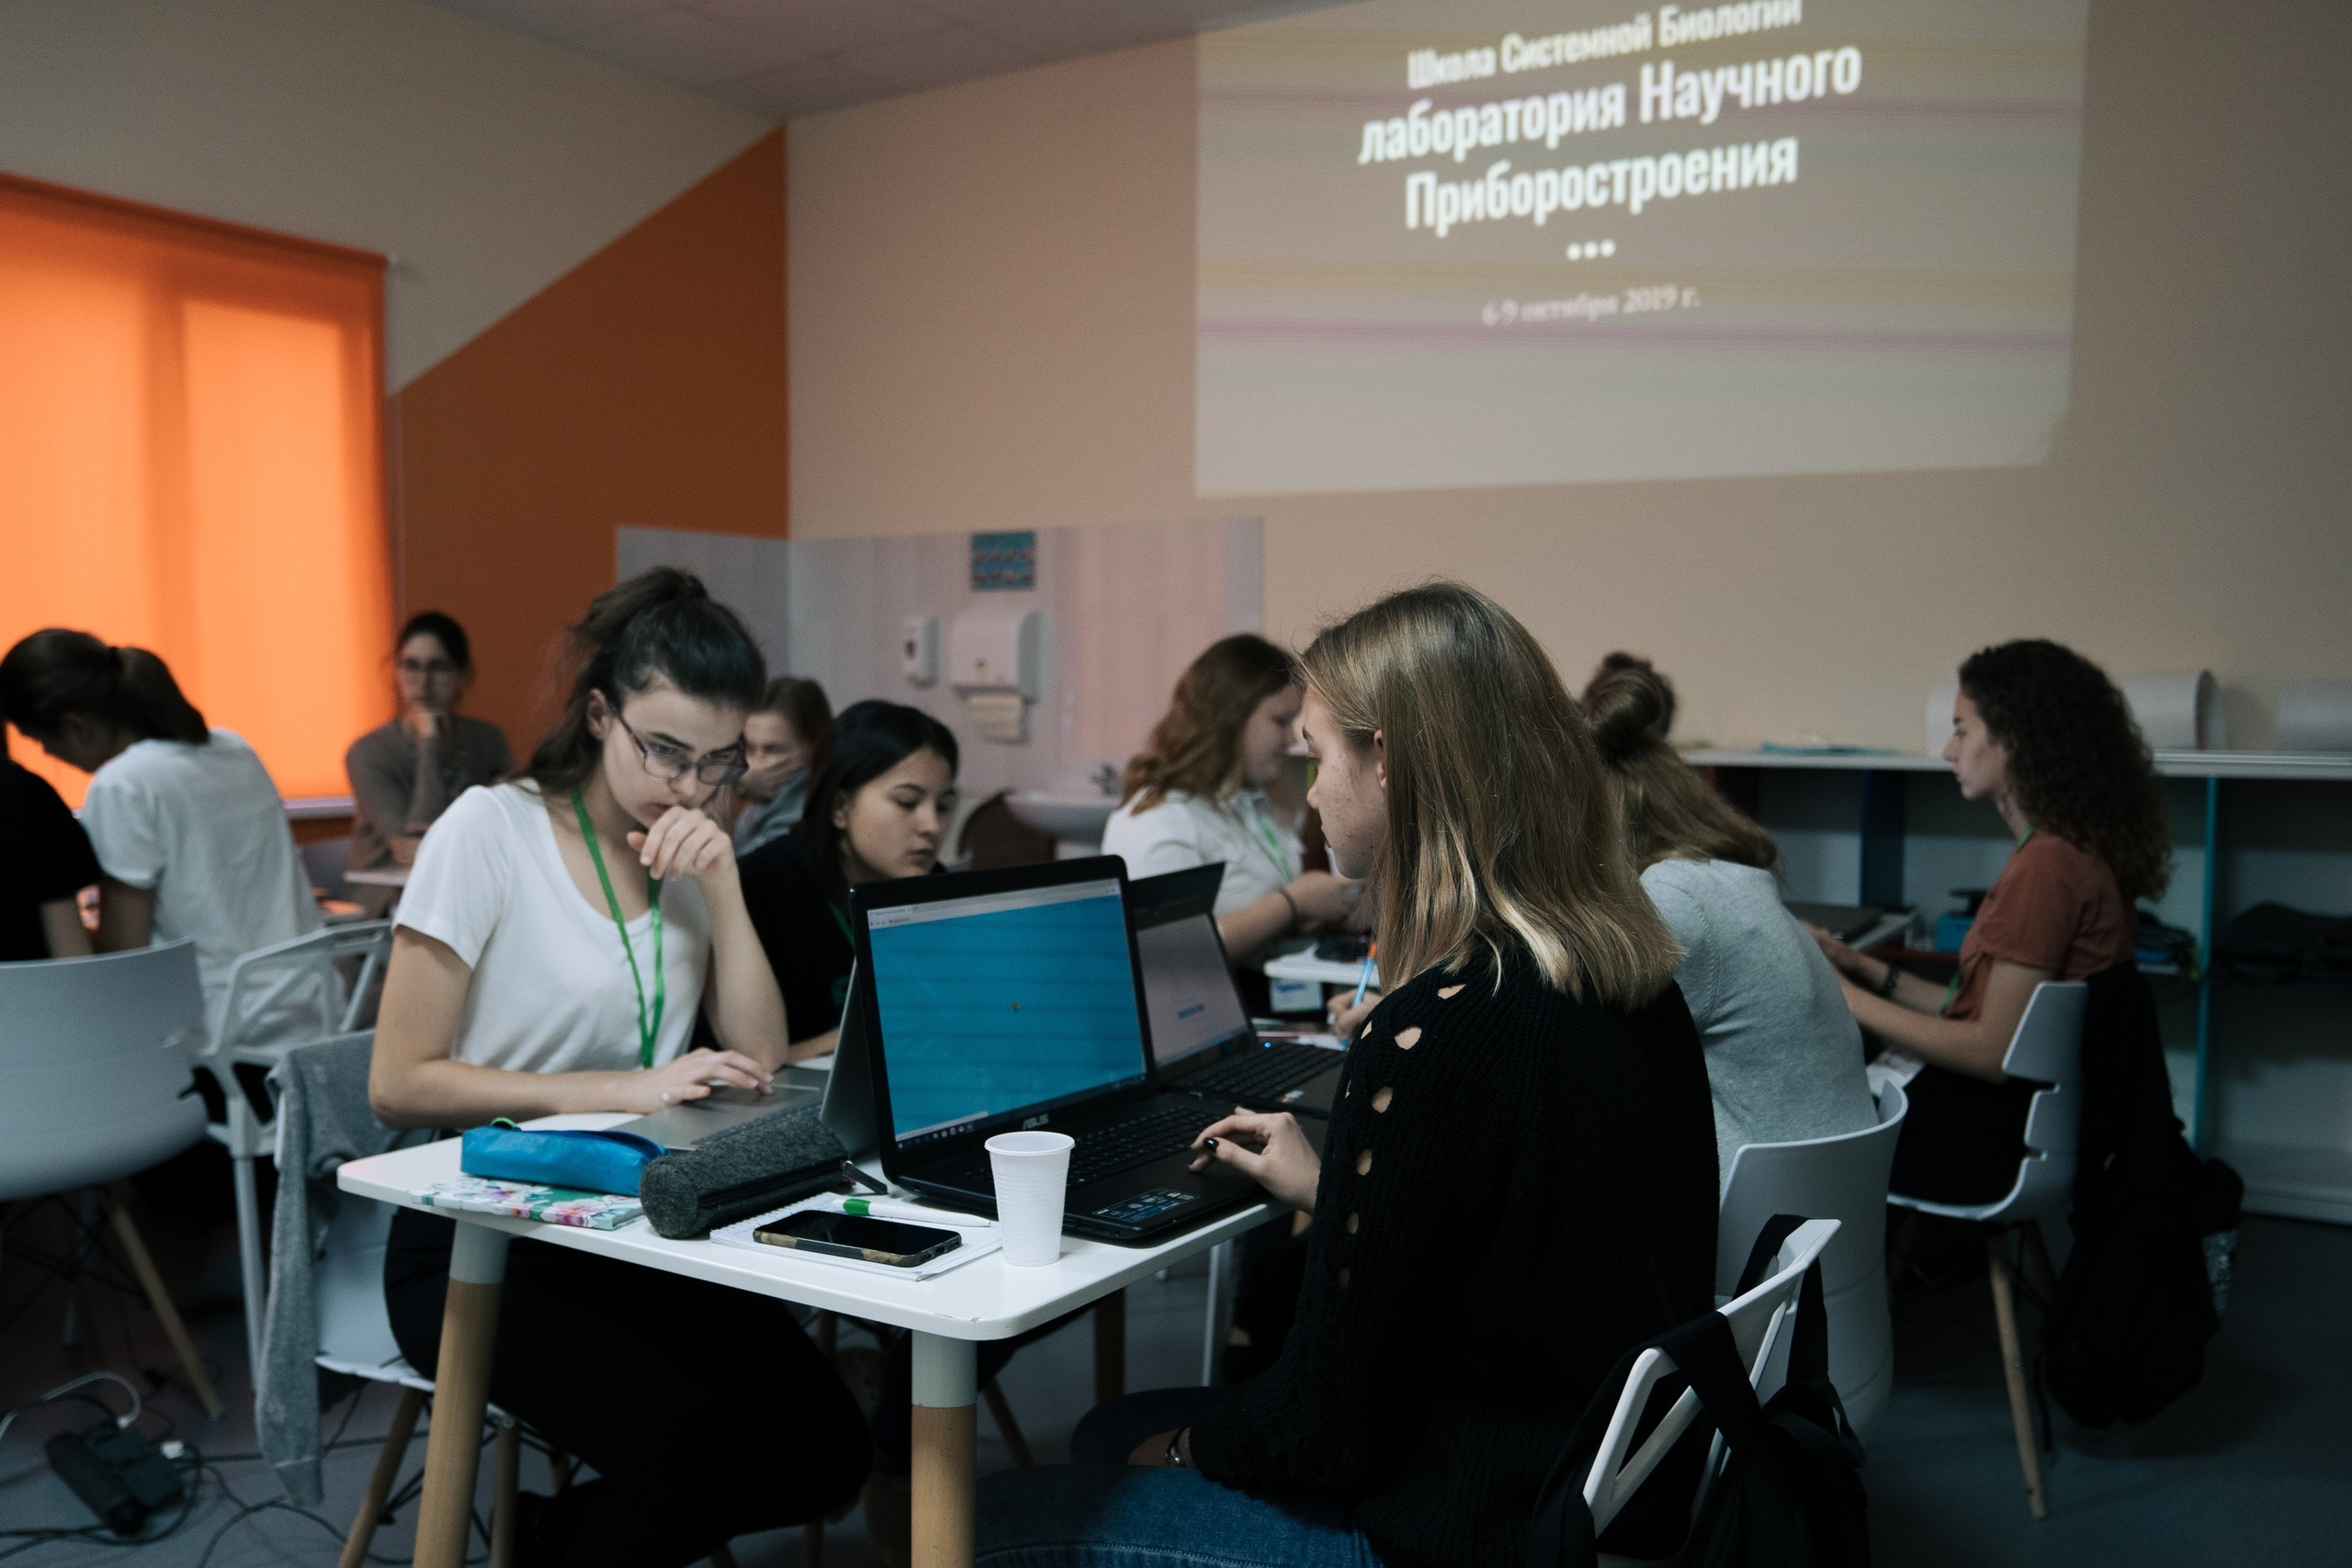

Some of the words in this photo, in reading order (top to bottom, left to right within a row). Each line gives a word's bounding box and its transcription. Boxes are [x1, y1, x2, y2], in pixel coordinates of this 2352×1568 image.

[1407, 48, 1497, 89] Школа
[1501, 13, 1653, 73] Системной
[1658, 0, 1803, 47] Биологии
[1357, 82, 1626, 164] лаборатория
[1639, 46, 1862, 125] Научного
[1405, 137, 1799, 238] Приборостроения
[1623, 284, 1678, 313] 2019
[1022, 1113, 1049, 1131] ASUS
